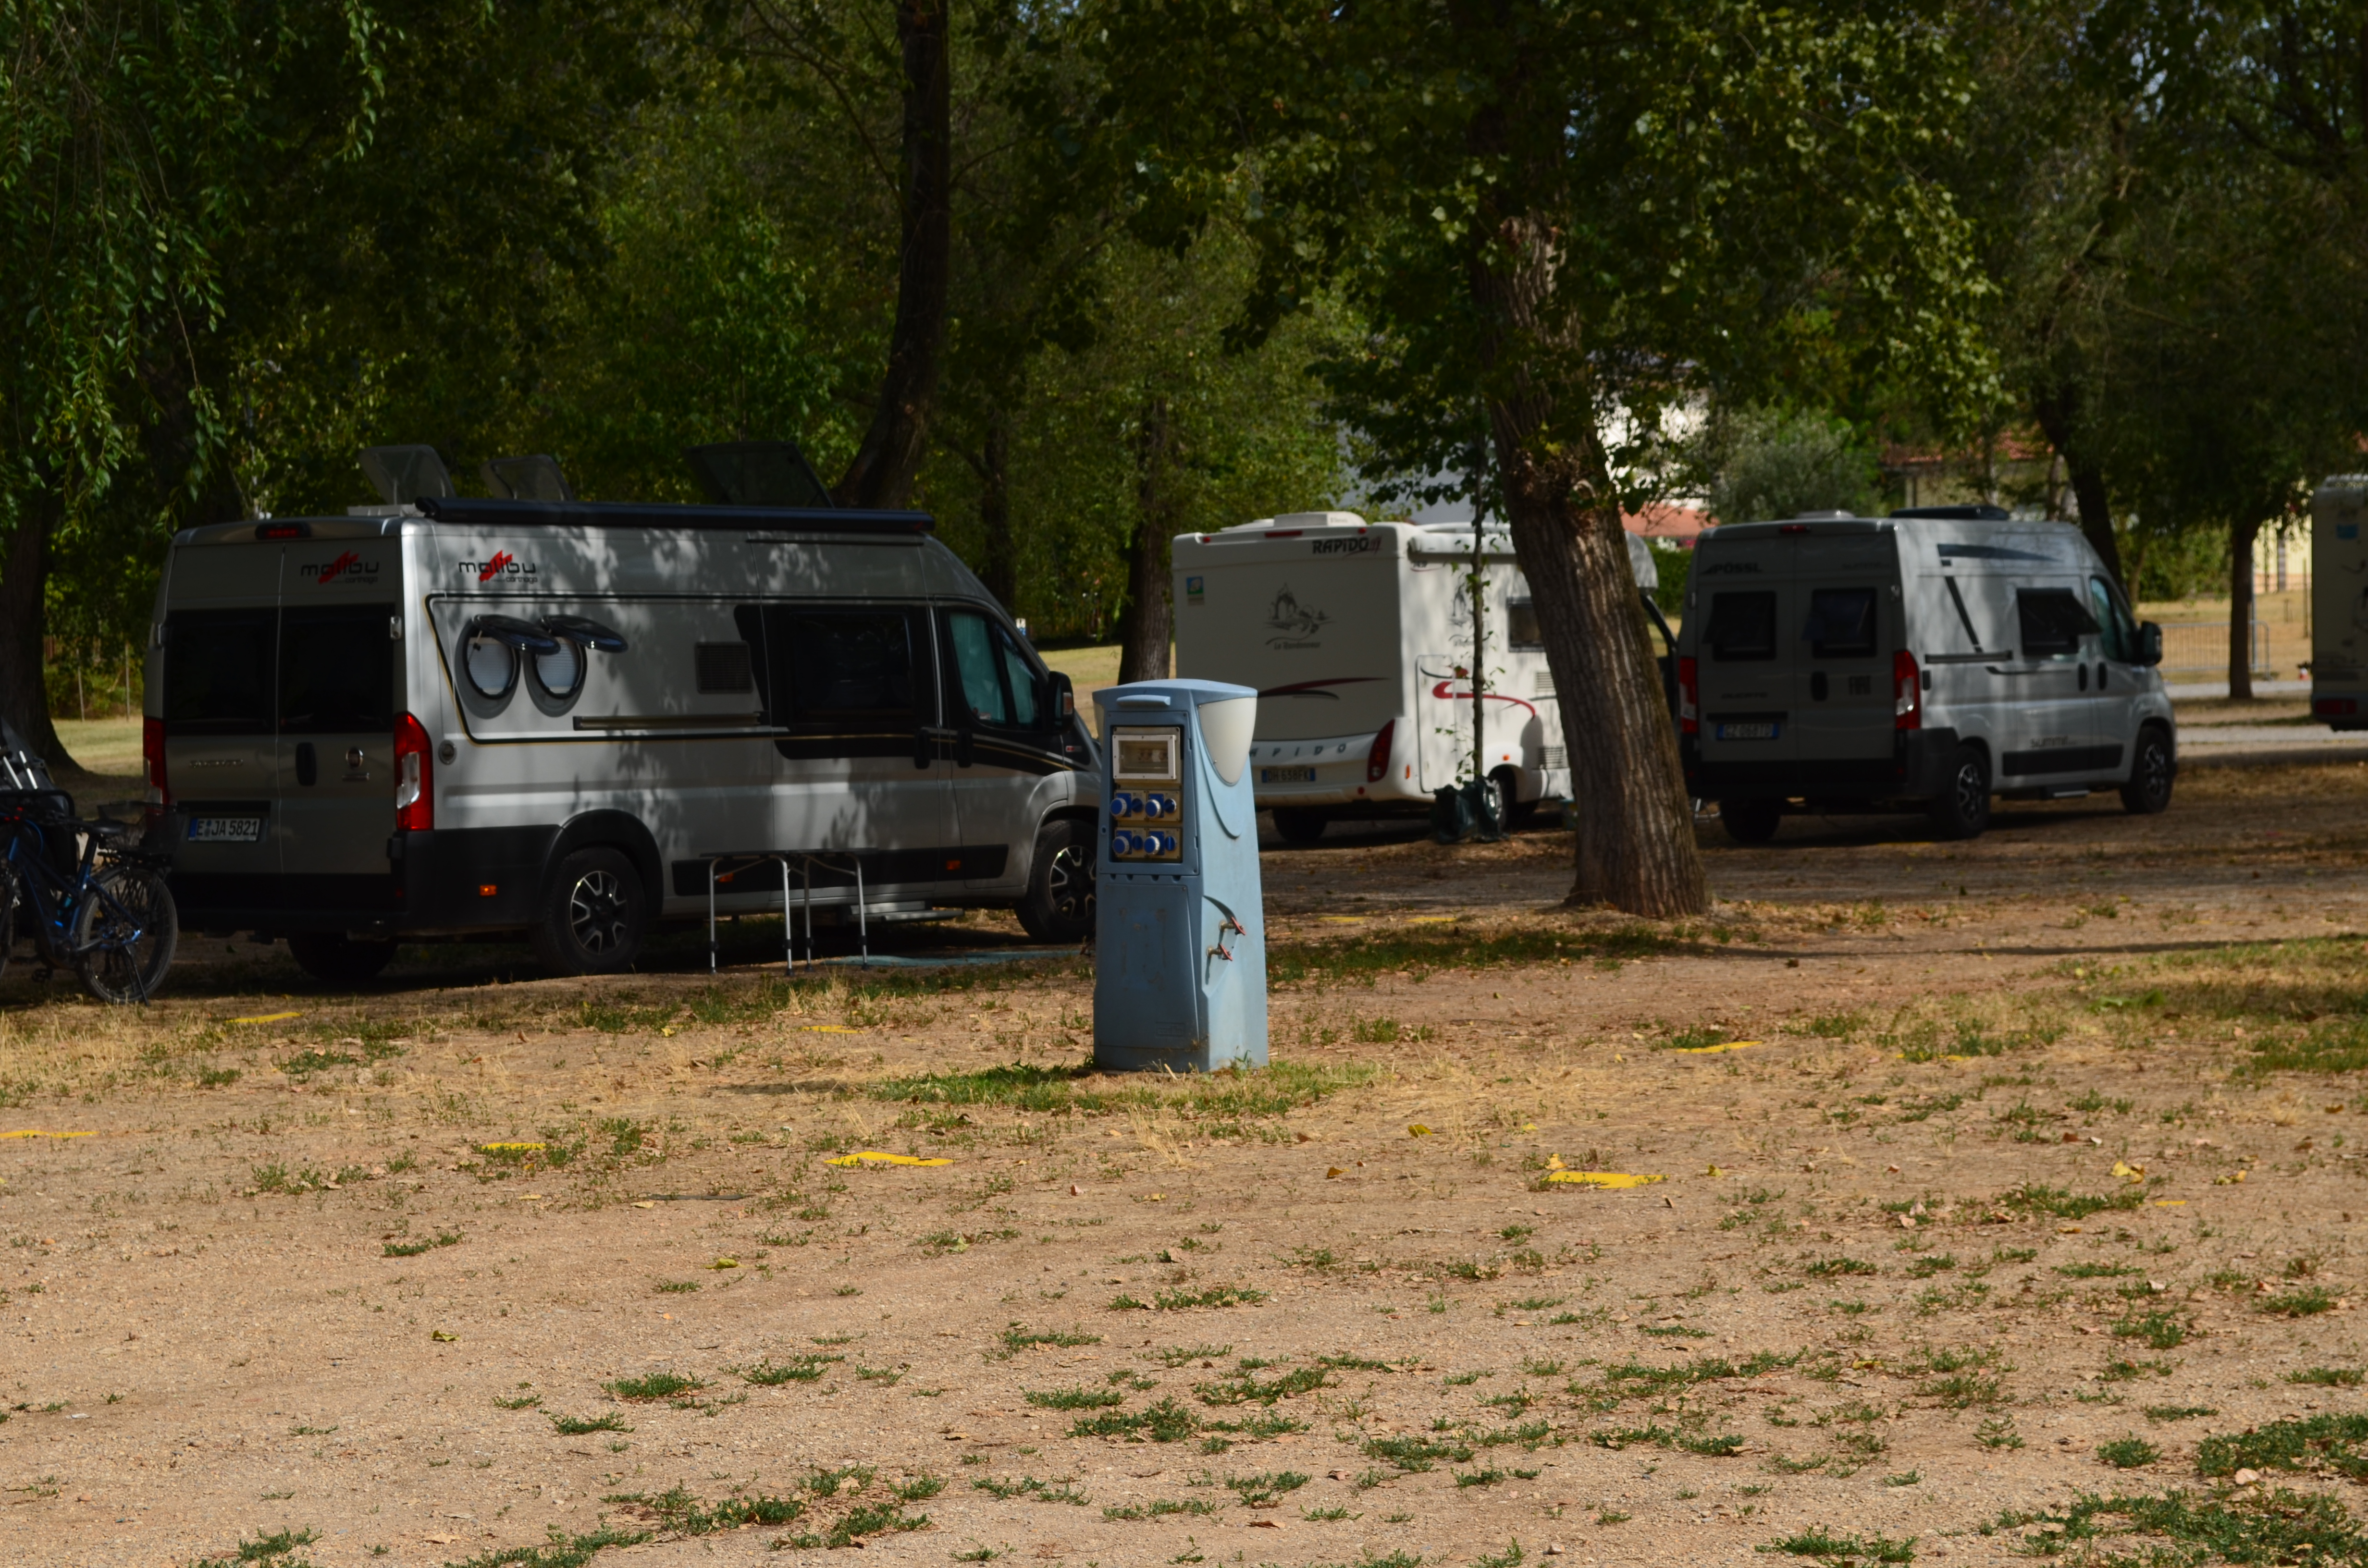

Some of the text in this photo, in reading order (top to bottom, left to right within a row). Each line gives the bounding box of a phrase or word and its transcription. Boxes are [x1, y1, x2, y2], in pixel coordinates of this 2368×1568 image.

[300, 558, 379, 576] malibu
[458, 557, 536, 573] malibu
[345, 576, 378, 585] carthago
[228, 820, 258, 836] 5821
